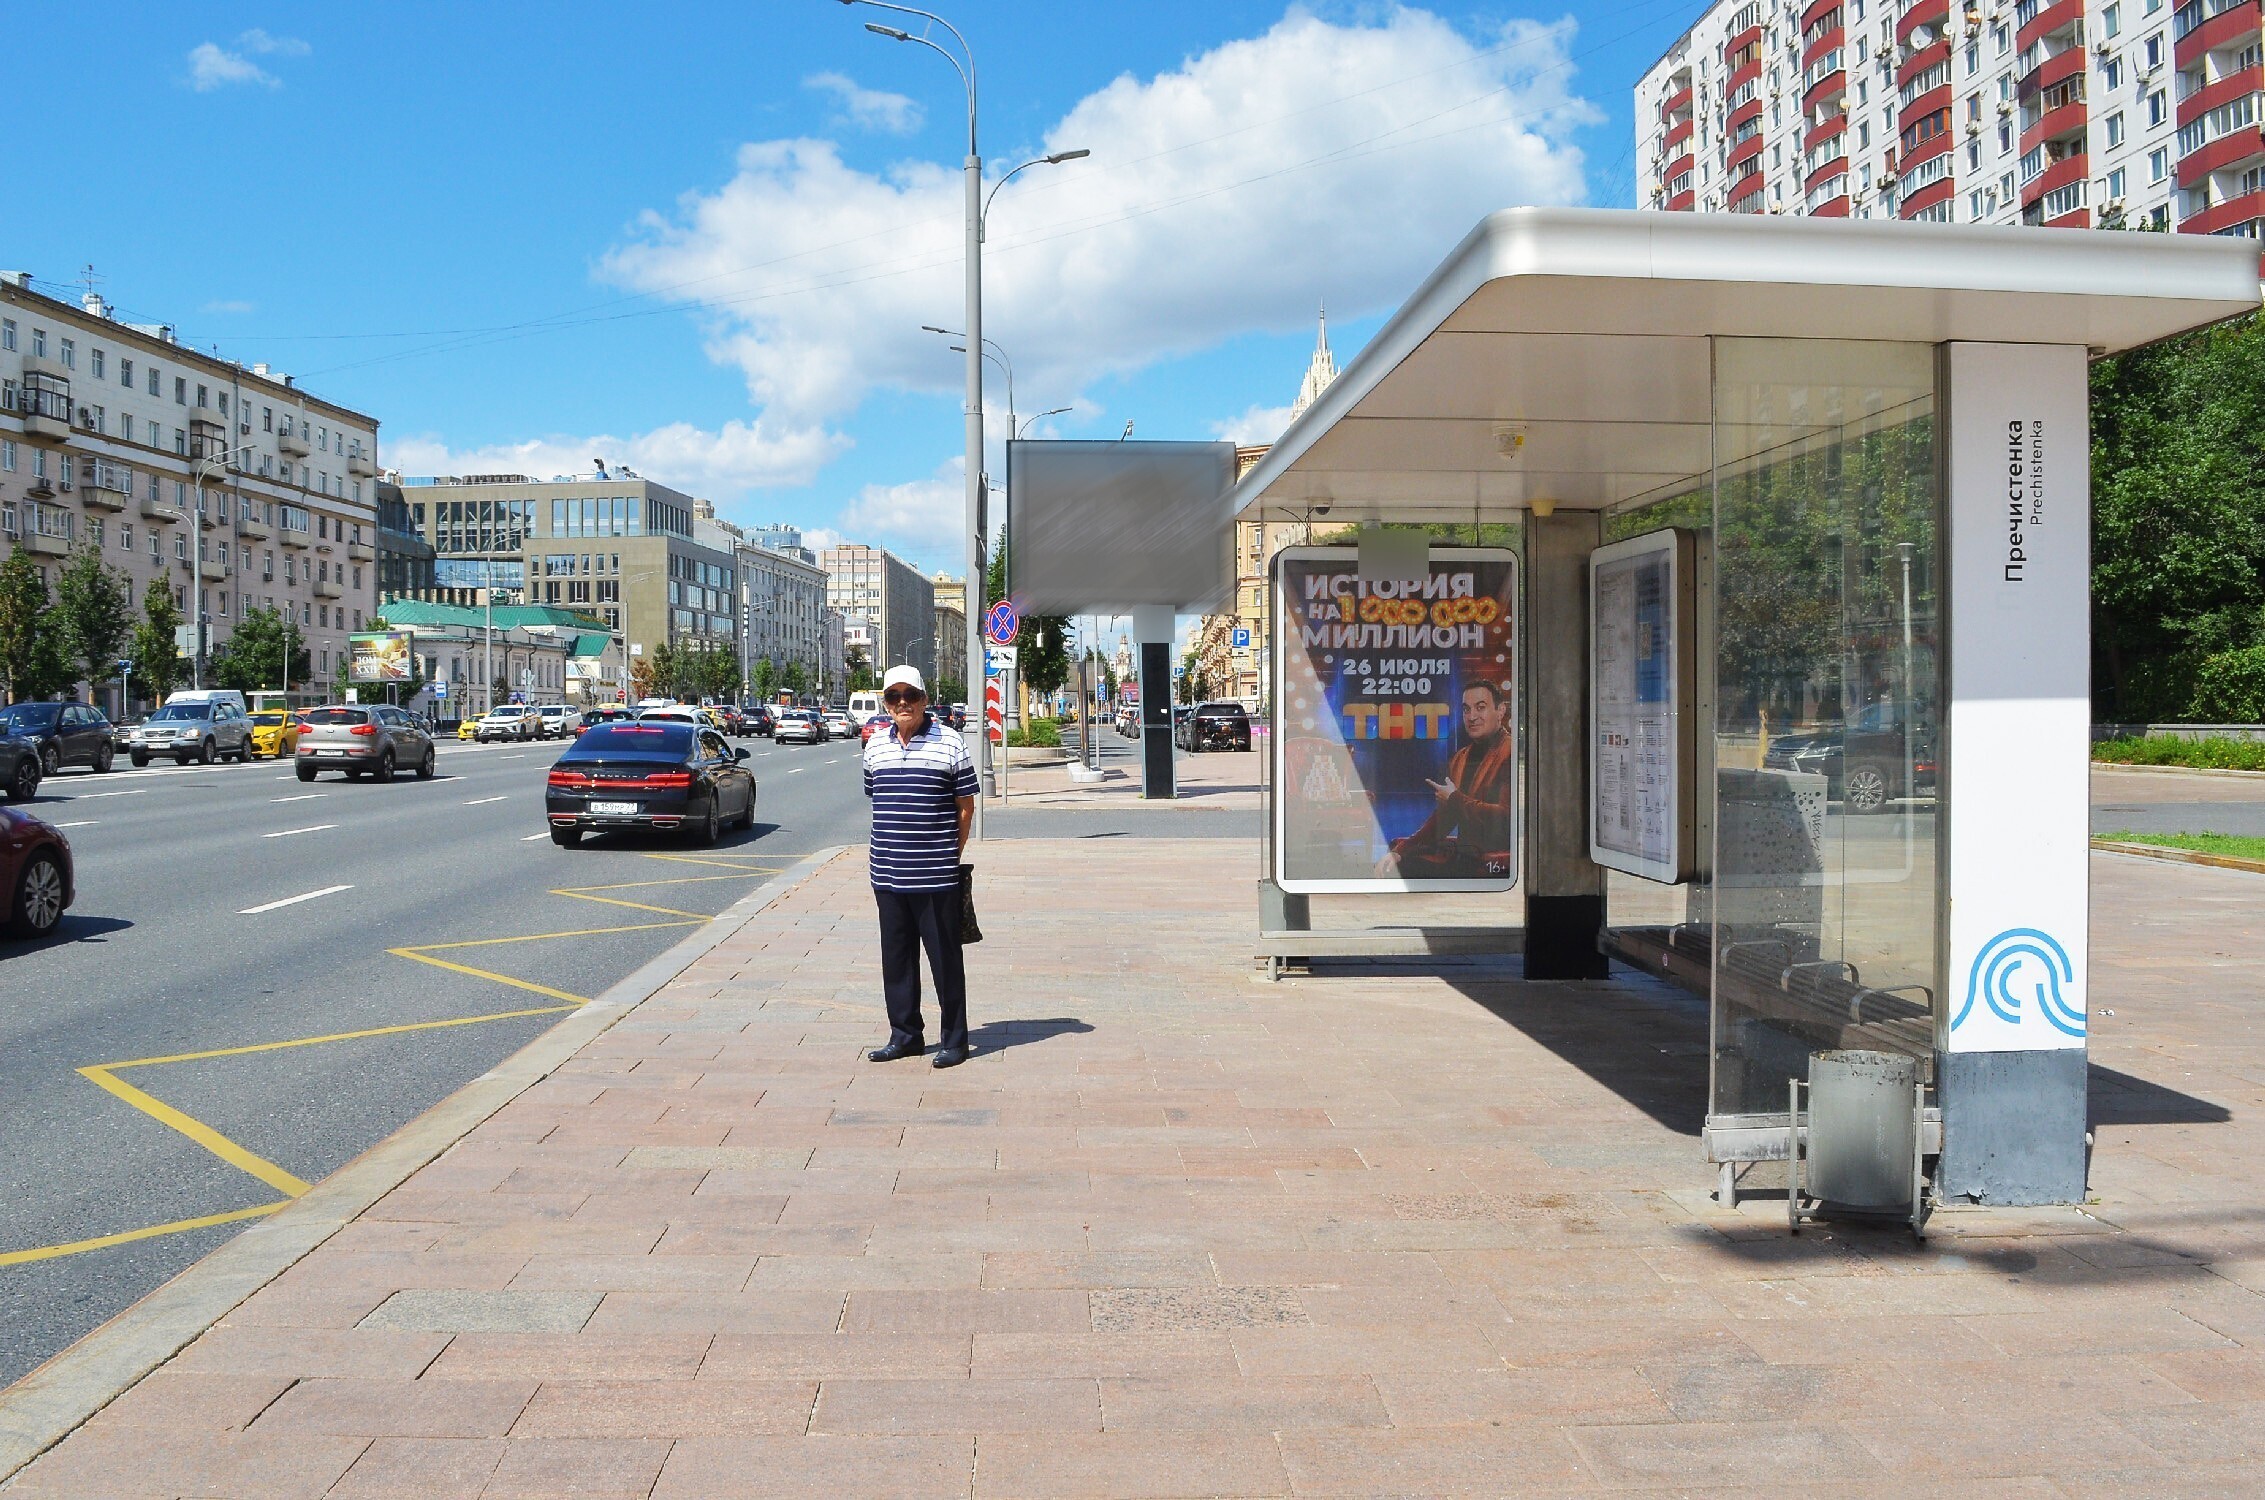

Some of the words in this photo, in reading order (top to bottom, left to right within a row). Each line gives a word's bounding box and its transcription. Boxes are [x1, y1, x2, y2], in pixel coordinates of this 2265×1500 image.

[2029, 420, 2042, 525] Prechistenka
[2004, 420, 2027, 581] Пречистенка
[1305, 573, 1474, 600] ИСТОРИЯ
[1308, 602, 1341, 620] НА
[1302, 624, 1485, 649] МИЛЛИОН
[1343, 658, 1372, 675] 26
[1380, 659, 1450, 675] ИЮЛЯ
[1362, 677, 1432, 695] 22:00
[1343, 703, 1450, 740] ТНТ
[1486, 861, 1505, 873] 16+
